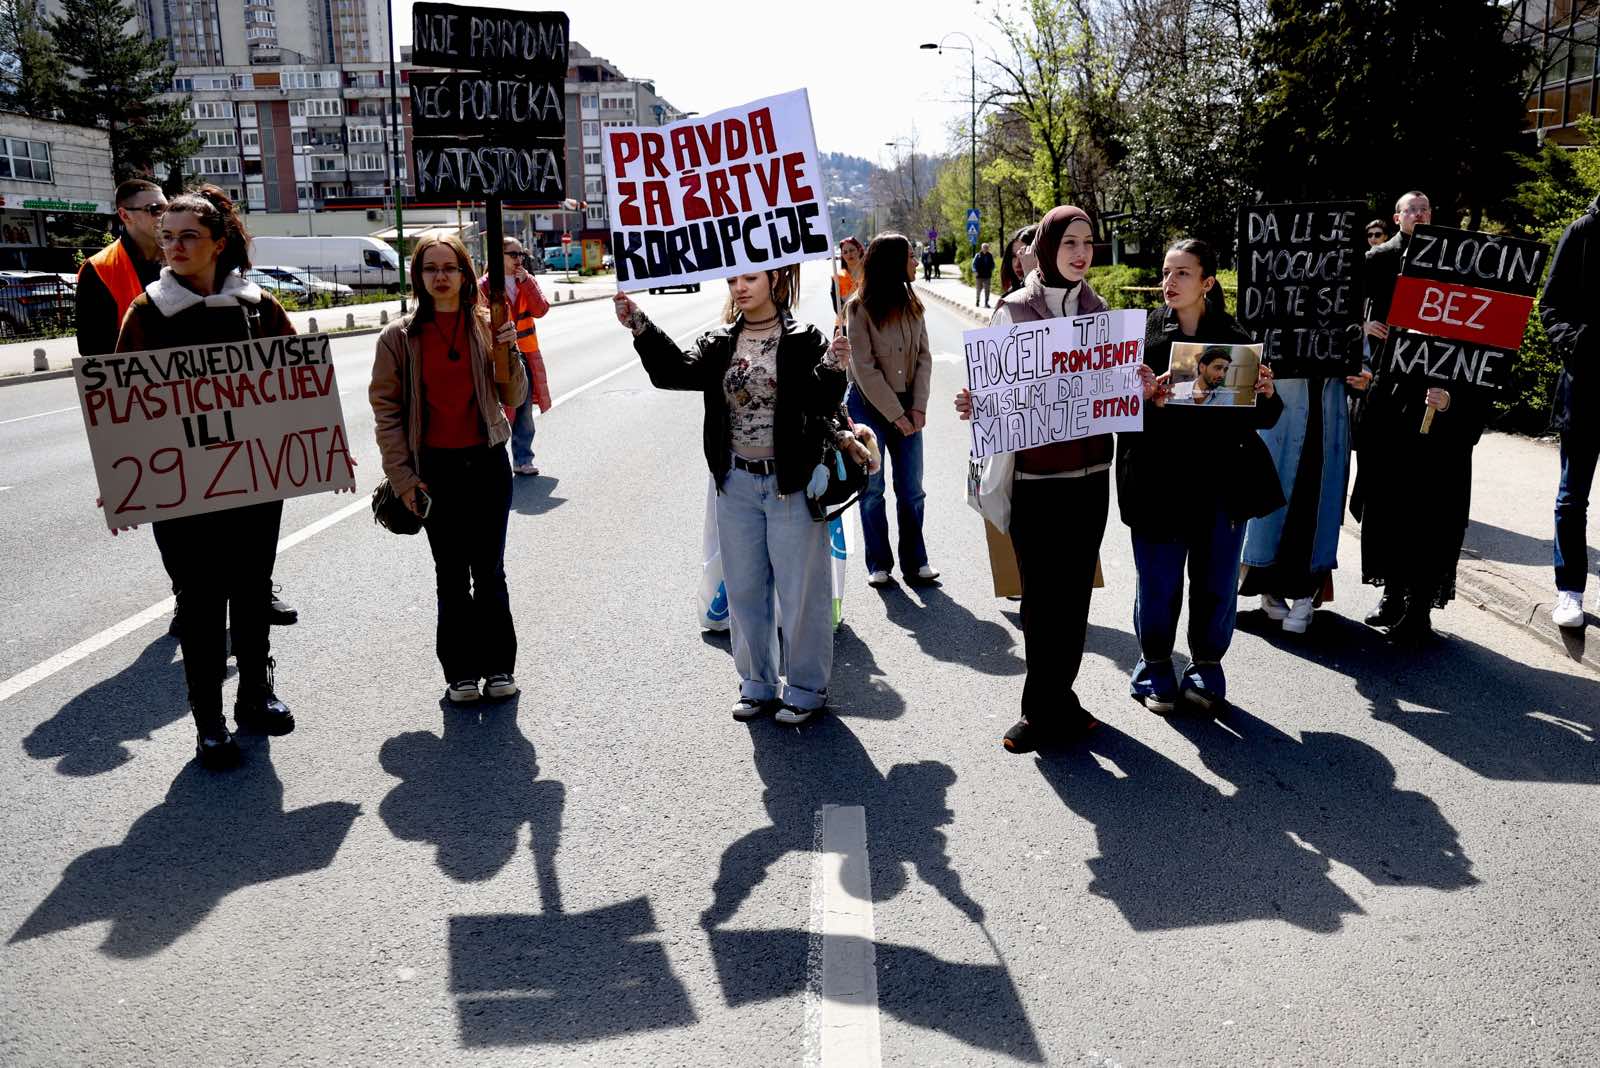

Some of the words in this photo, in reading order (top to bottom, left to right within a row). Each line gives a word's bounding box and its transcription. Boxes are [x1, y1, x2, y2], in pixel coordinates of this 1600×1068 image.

[412, 75, 450, 119] VEĆ
[610, 107, 777, 178] PRAVDA
[416, 147, 563, 195] KATASTROFA
[617, 180, 674, 226] ZA
[679, 152, 814, 221] ŽRTVE
[1248, 212, 1280, 244] DA
[1290, 212, 1315, 243] LI
[1319, 211, 1355, 242] JE
[1251, 244, 1353, 283] MOGUĆE
[1411, 233, 1540, 284] ZLOČIN
[1245, 286, 1276, 319] DA
[1284, 285, 1309, 316] TE
[1316, 286, 1350, 315] SE
[1418, 287, 1492, 330] BEZ
[1072, 313, 1110, 347] TA
[81, 357, 155, 392] ŠTA
[149, 344, 254, 382] VRIJEDI
[253, 335, 330, 370] VIŠE?
[1389, 337, 1504, 389] KAZNE.
[971, 382, 1046, 420] MISLIM
[1057, 375, 1083, 401] DA
[1090, 370, 1114, 396] JE
[1119, 364, 1144, 390] TO
[181, 410, 235, 448] ILI
[972, 397, 1090, 458] MANJE
[1092, 394, 1140, 419] BITNO
[111, 447, 187, 515] 29
[203, 424, 356, 500] ŽIVOTA
